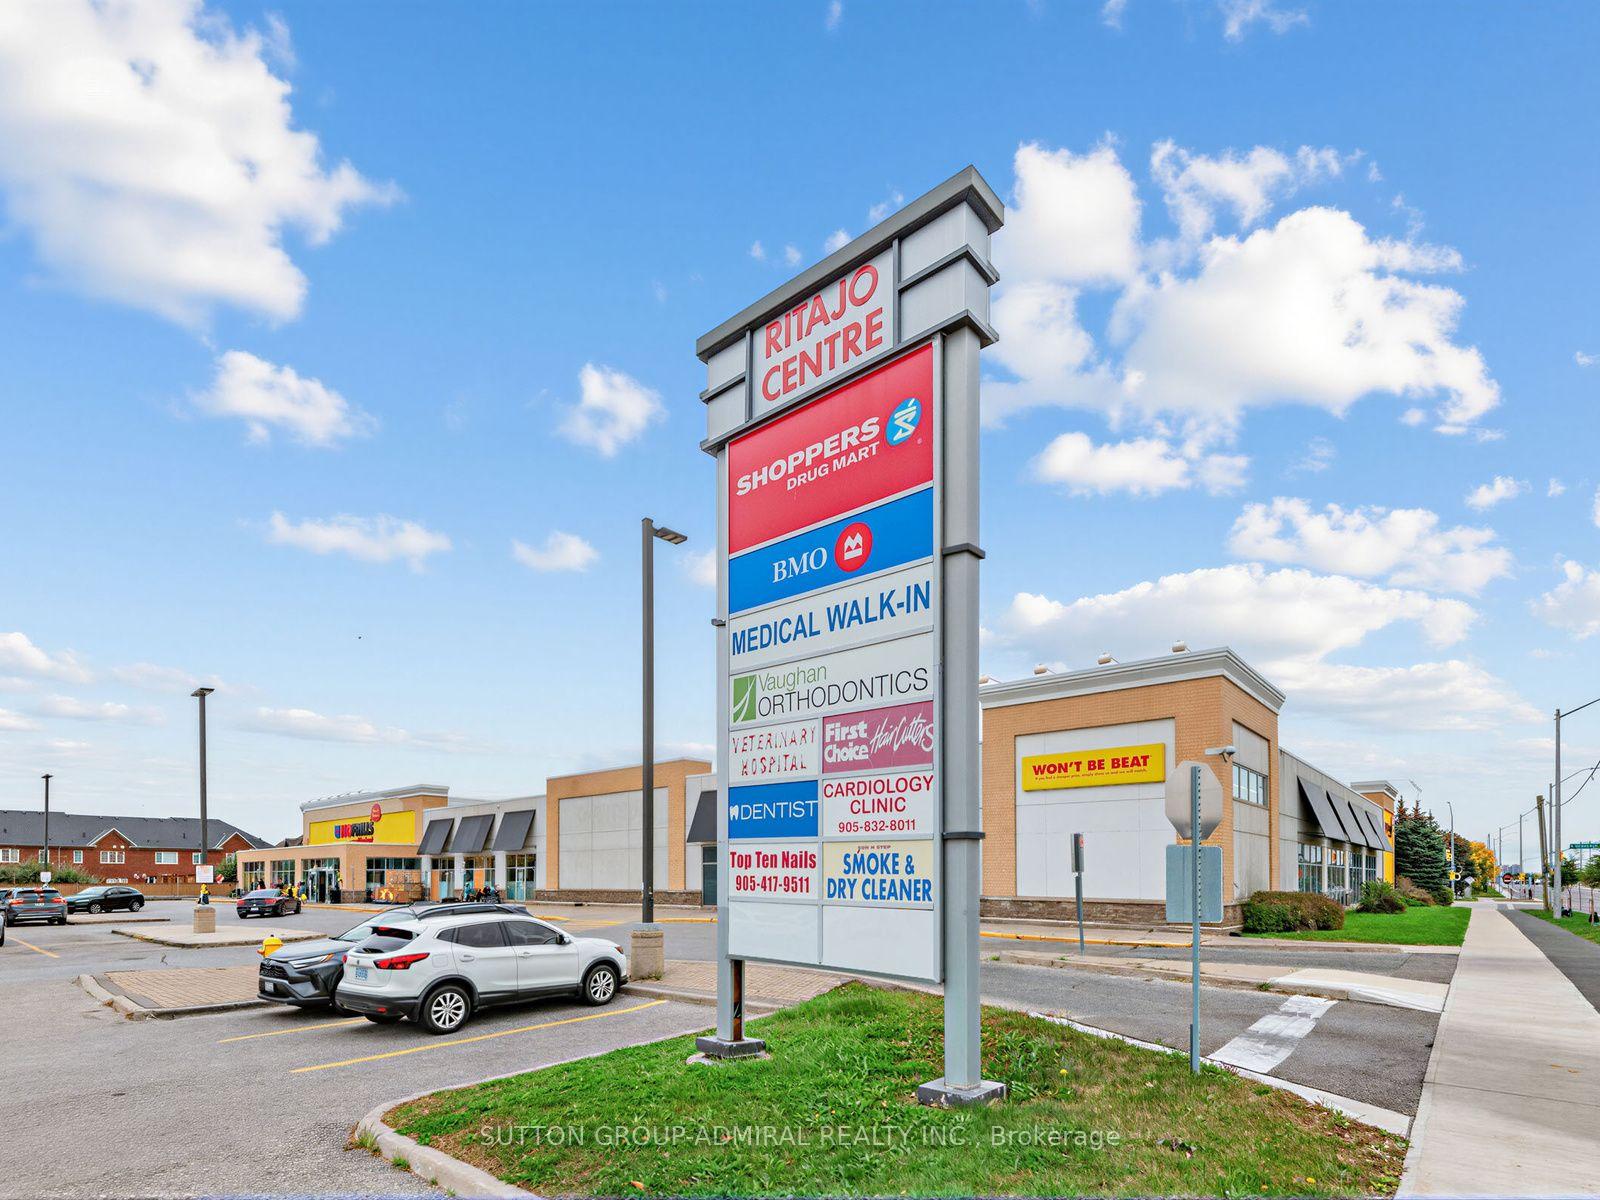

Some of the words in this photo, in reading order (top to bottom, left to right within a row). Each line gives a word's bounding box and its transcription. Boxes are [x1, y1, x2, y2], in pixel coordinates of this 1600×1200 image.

[765, 264, 879, 359] RITAJO
[761, 307, 883, 401] CENTRE
[736, 416, 880, 496] SHOPPERS
[786, 461, 829, 491] DRUG
[832, 441, 880, 469] MART
[772, 547, 828, 583] BMO
[732, 612, 820, 655] MEDICAL
[826, 581, 931, 632] WALK-IN
[758, 665, 827, 692] Vaughan
[758, 667, 928, 717] ORTHODONTICS
[825, 721, 868, 742] First
[824, 742, 869, 763] Choice
[1032, 761, 1082, 776] WON'T
[1087, 759, 1105, 771] BE
[1111, 754, 1150, 769] BEAT
[823, 775, 934, 798] CARDIOLOGY
[741, 800, 818, 820] DENTIST
[850, 797, 906, 815] CLINIC
[838, 819, 916, 833] 905-832-8011
[730, 851, 752, 870] Top
[755, 851, 778, 868] Ten
[781, 851, 817, 869] Nails
[843, 852, 900, 875] SMOKE
[905, 854, 915, 874] &
[735, 875, 810, 893] 905-417-9511
[827, 879, 857, 900] DRY
[861, 878, 933, 902] CLEANER
